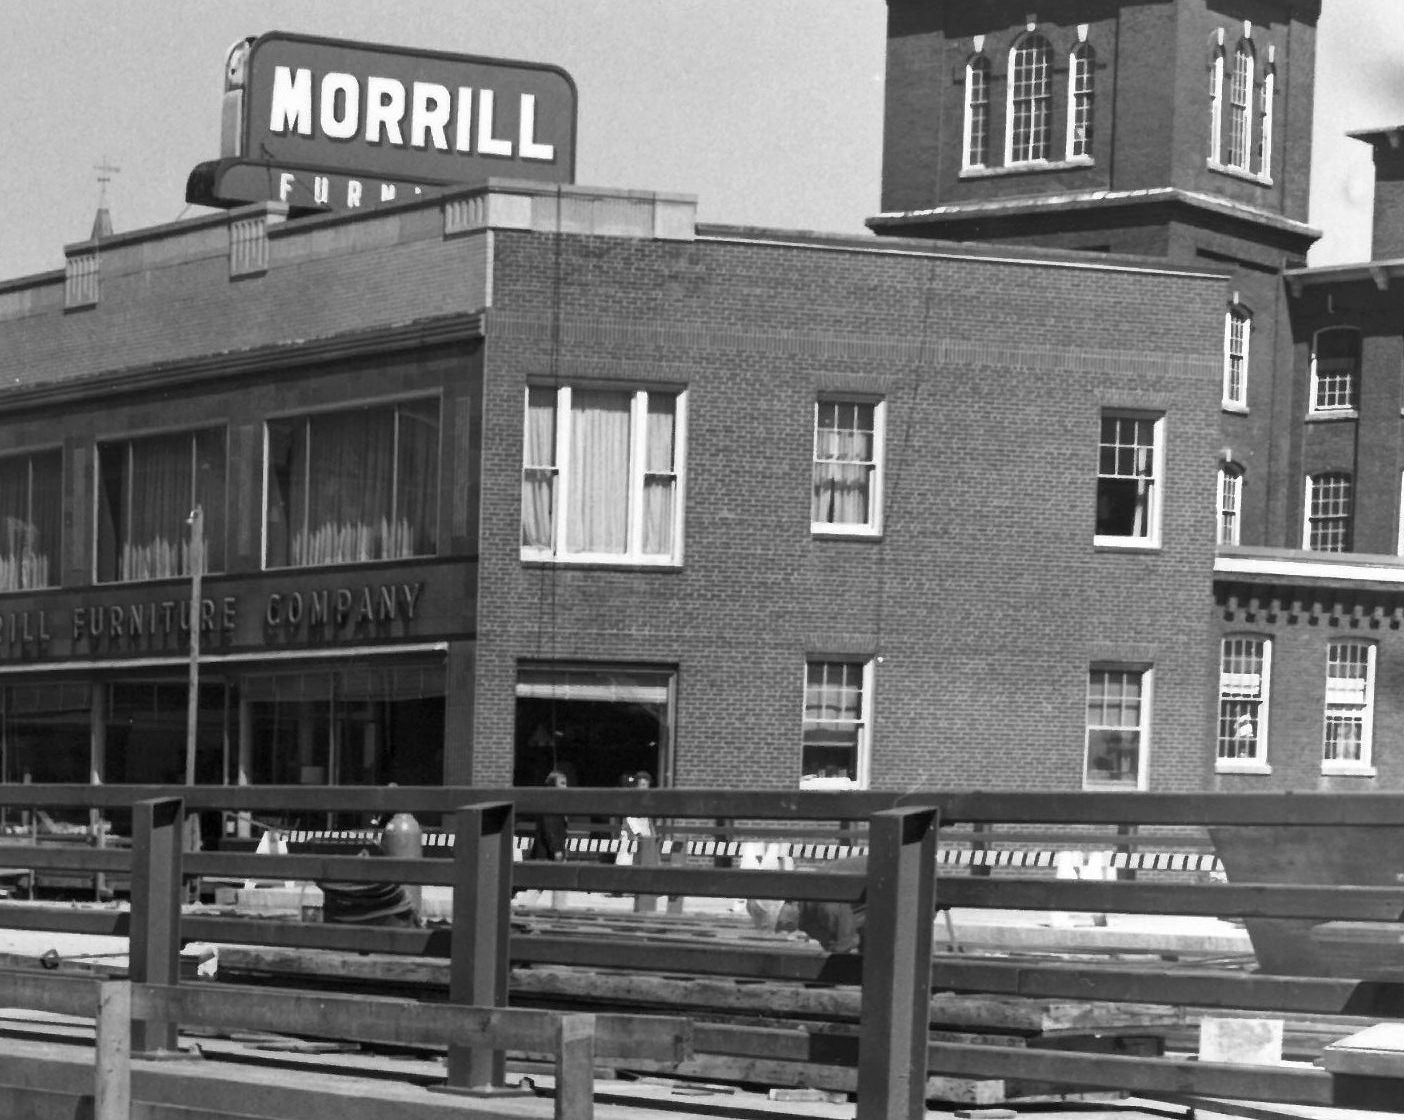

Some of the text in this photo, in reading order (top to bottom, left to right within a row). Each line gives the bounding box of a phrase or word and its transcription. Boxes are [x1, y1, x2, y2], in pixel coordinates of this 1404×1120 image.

[269, 65, 554, 160] MORRILL
[279, 172, 422, 208] FURN
[73, 596, 236, 638] FURNITURE
[266, 582, 421, 626] COMPANY
